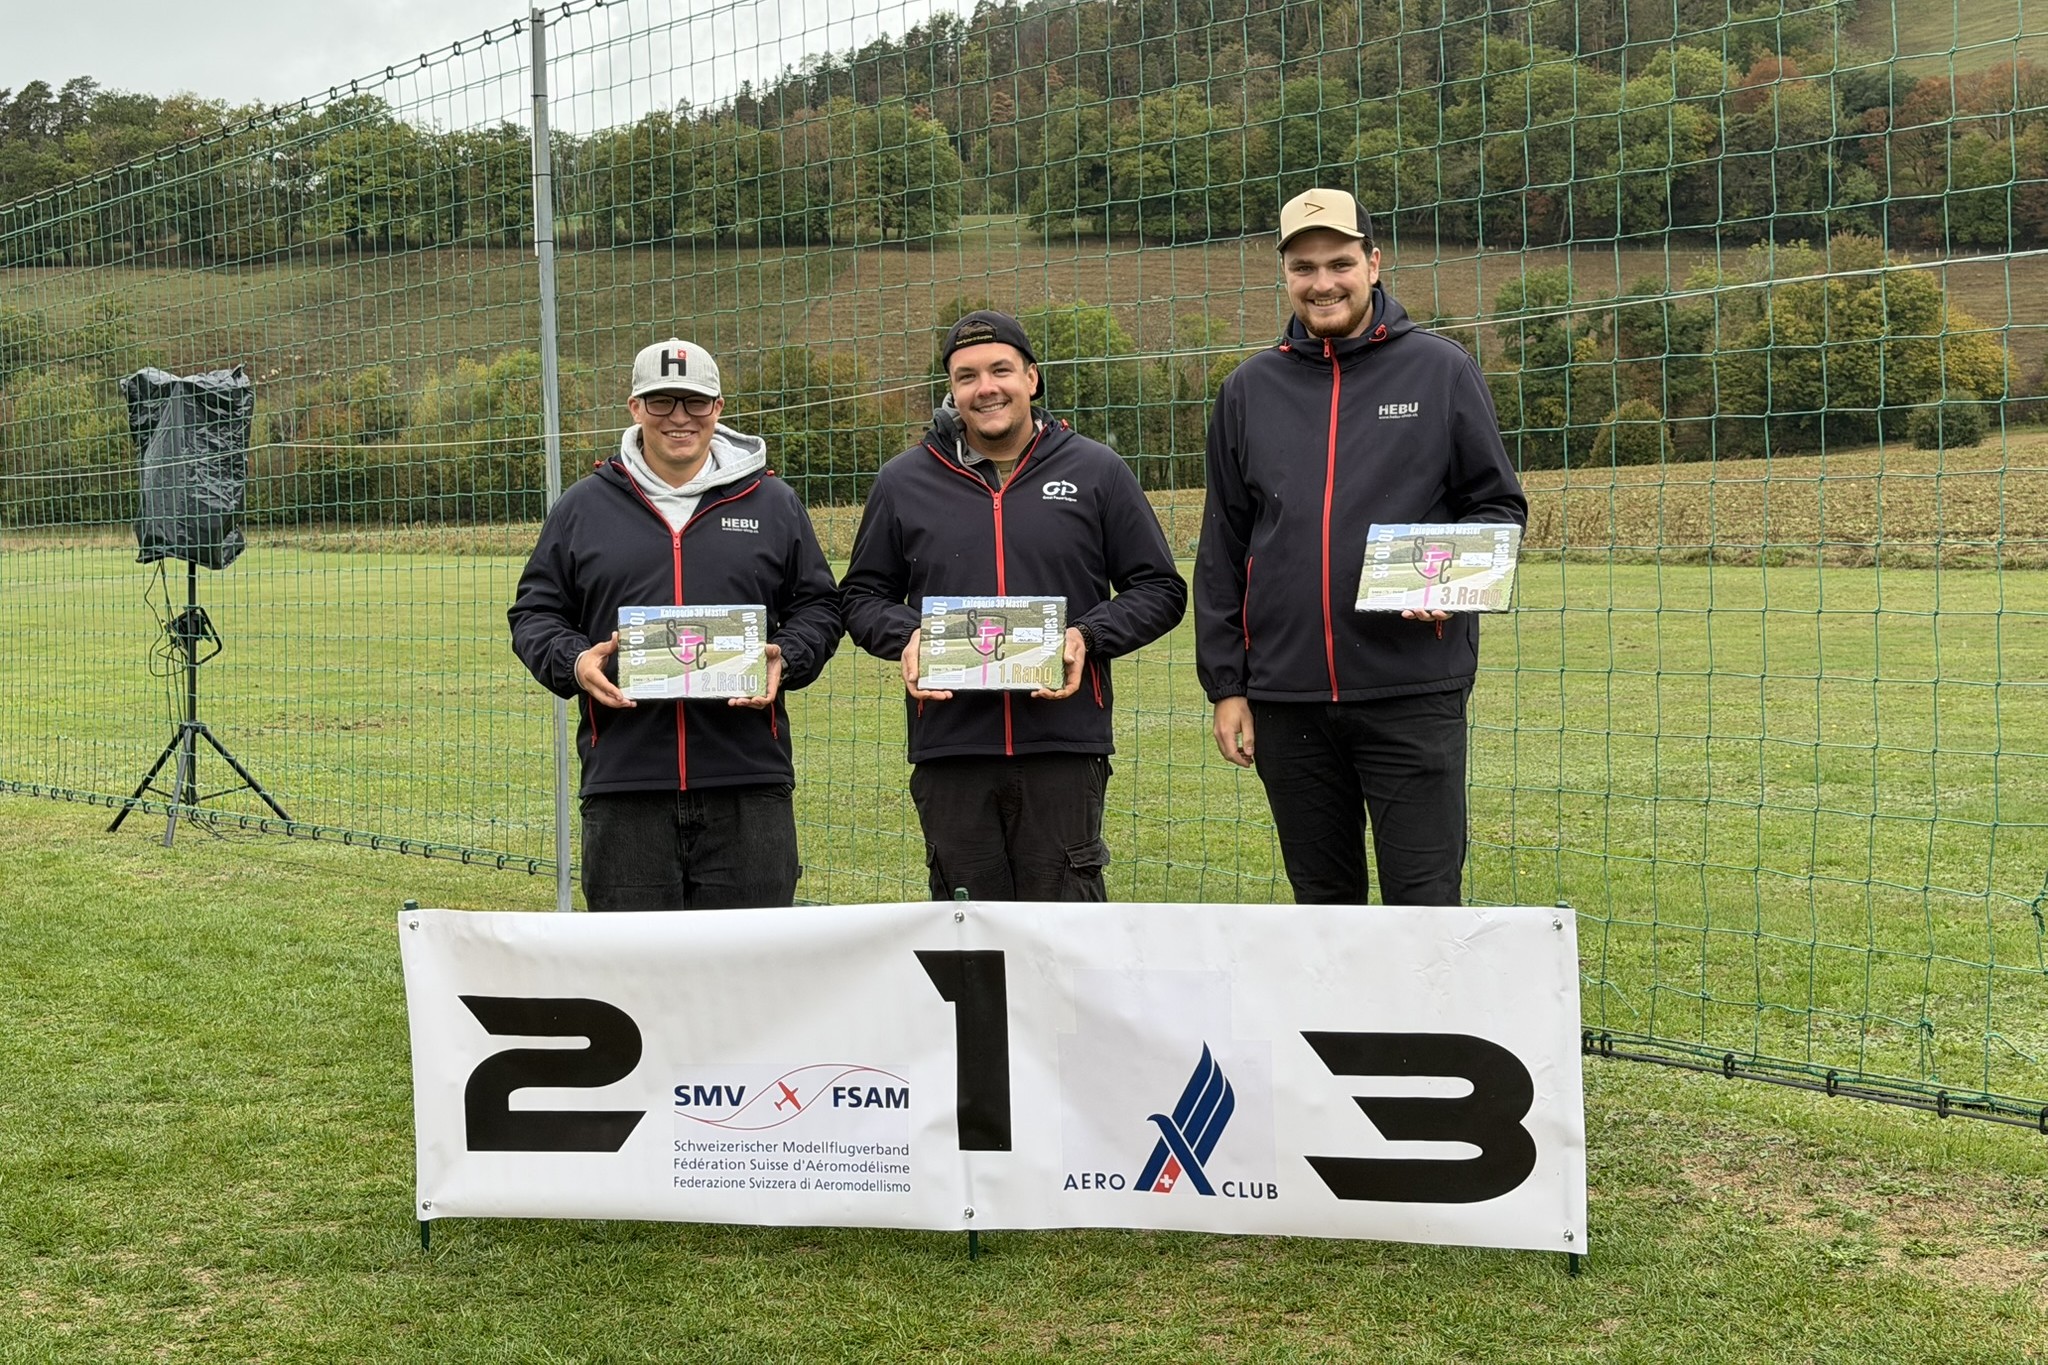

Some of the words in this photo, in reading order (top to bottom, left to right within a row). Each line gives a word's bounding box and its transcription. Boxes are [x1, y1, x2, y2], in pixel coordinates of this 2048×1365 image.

[1379, 402, 1419, 415] HEBU
[721, 518, 759, 529] HEBU
[1440, 586, 1501, 606] 3.Rang
[701, 672, 758, 692] 2.Rang
[999, 663, 1053, 685] 1.Rang
[913, 950, 1012, 1151] 1
[458, 995, 646, 1152] 2
[675, 1085, 747, 1108] SMV
[833, 1087, 909, 1108] FSAM
[1300, 1031, 1536, 1204] 3
[674, 1140, 777, 1153] Schweizerischer
[782, 1141, 910, 1157] Modellflugverband
[673, 1158, 746, 1171] Fédération
[750, 1158, 789, 1171] Suisse
[793, 1158, 911, 1175] d'Aéromodélisme
[673, 1176, 746, 1189] Federazione
[749, 1176, 797, 1190] Svizzera
[800, 1177, 811, 1191] di
[814, 1177, 911, 1193] Aeromodellismo
[1064, 1173, 1125, 1190] AERO
[1222, 1181, 1278, 1199] CLUB
